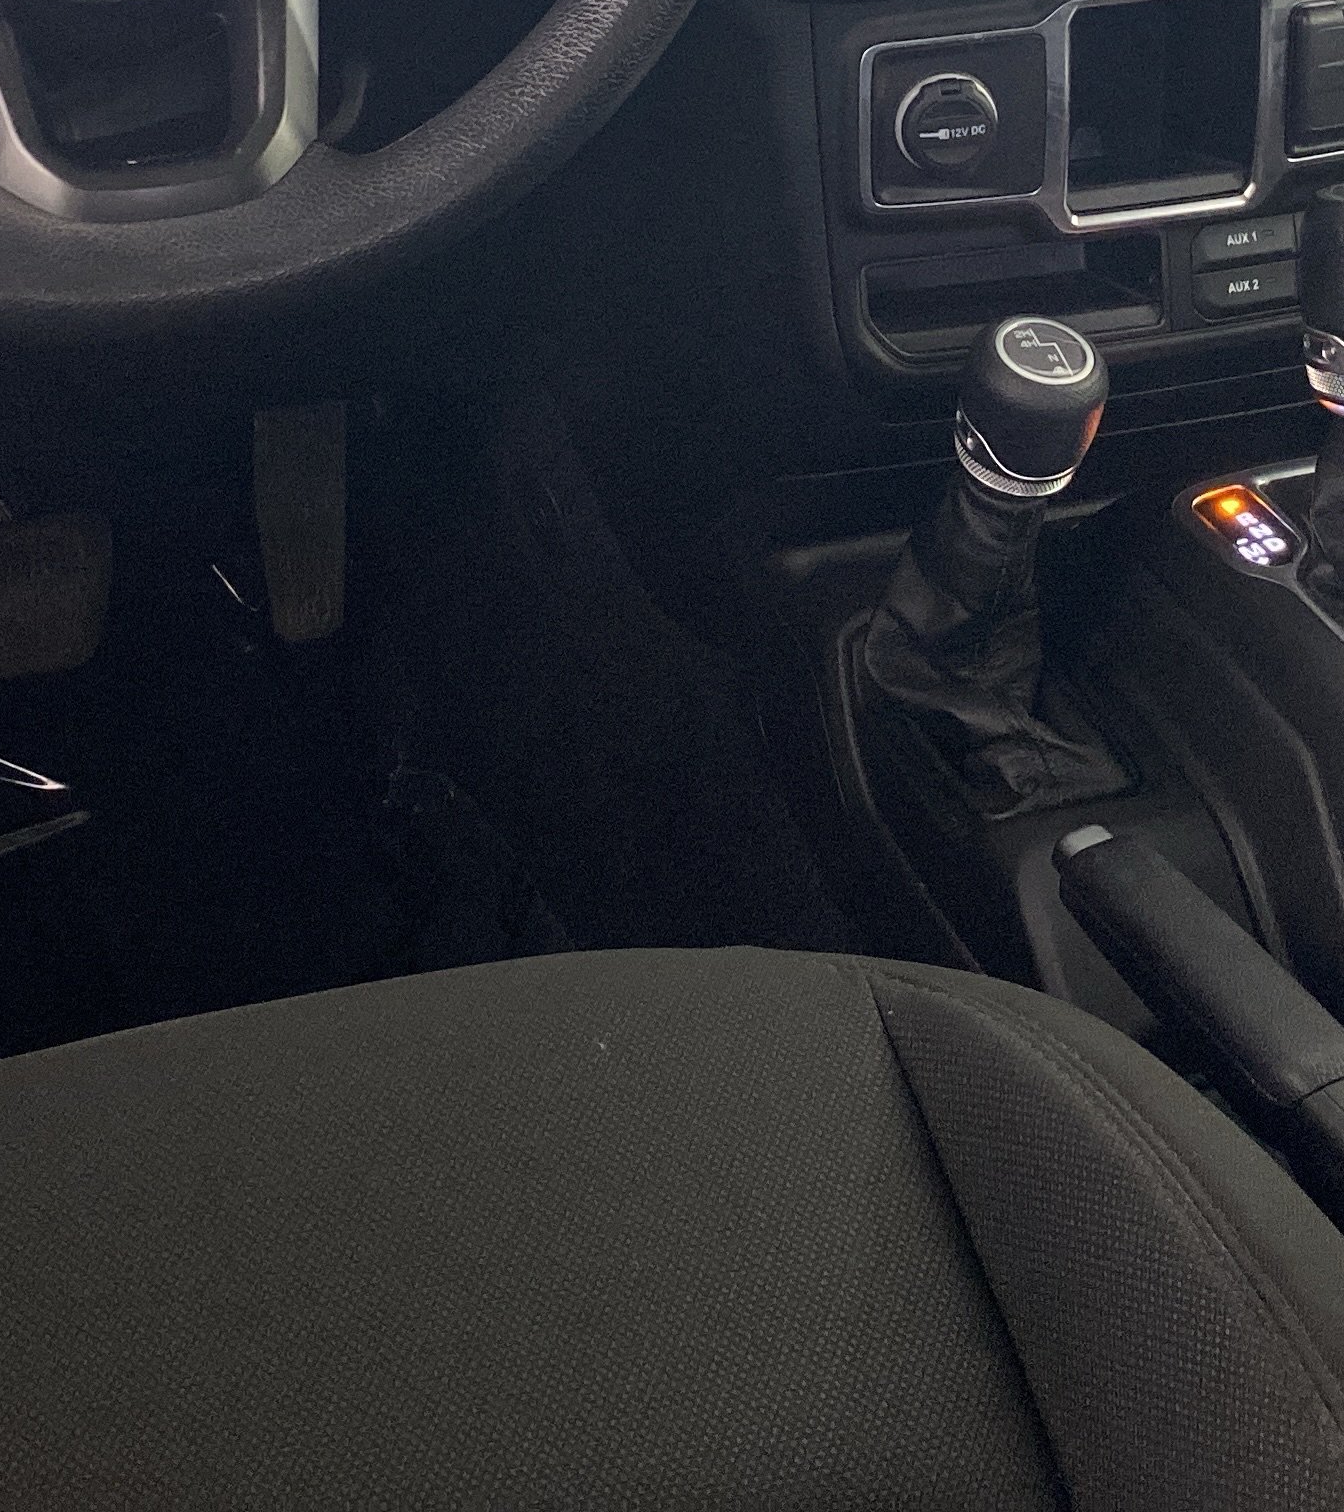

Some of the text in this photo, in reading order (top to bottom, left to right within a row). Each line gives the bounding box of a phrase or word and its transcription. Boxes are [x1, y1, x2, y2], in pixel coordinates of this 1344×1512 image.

[950, 124, 986, 139] 12V DC
[1226, 232, 1249, 247] AUX
[1228, 279, 1259, 294] AUX 2
[1048, 353, 1059, 362] N
